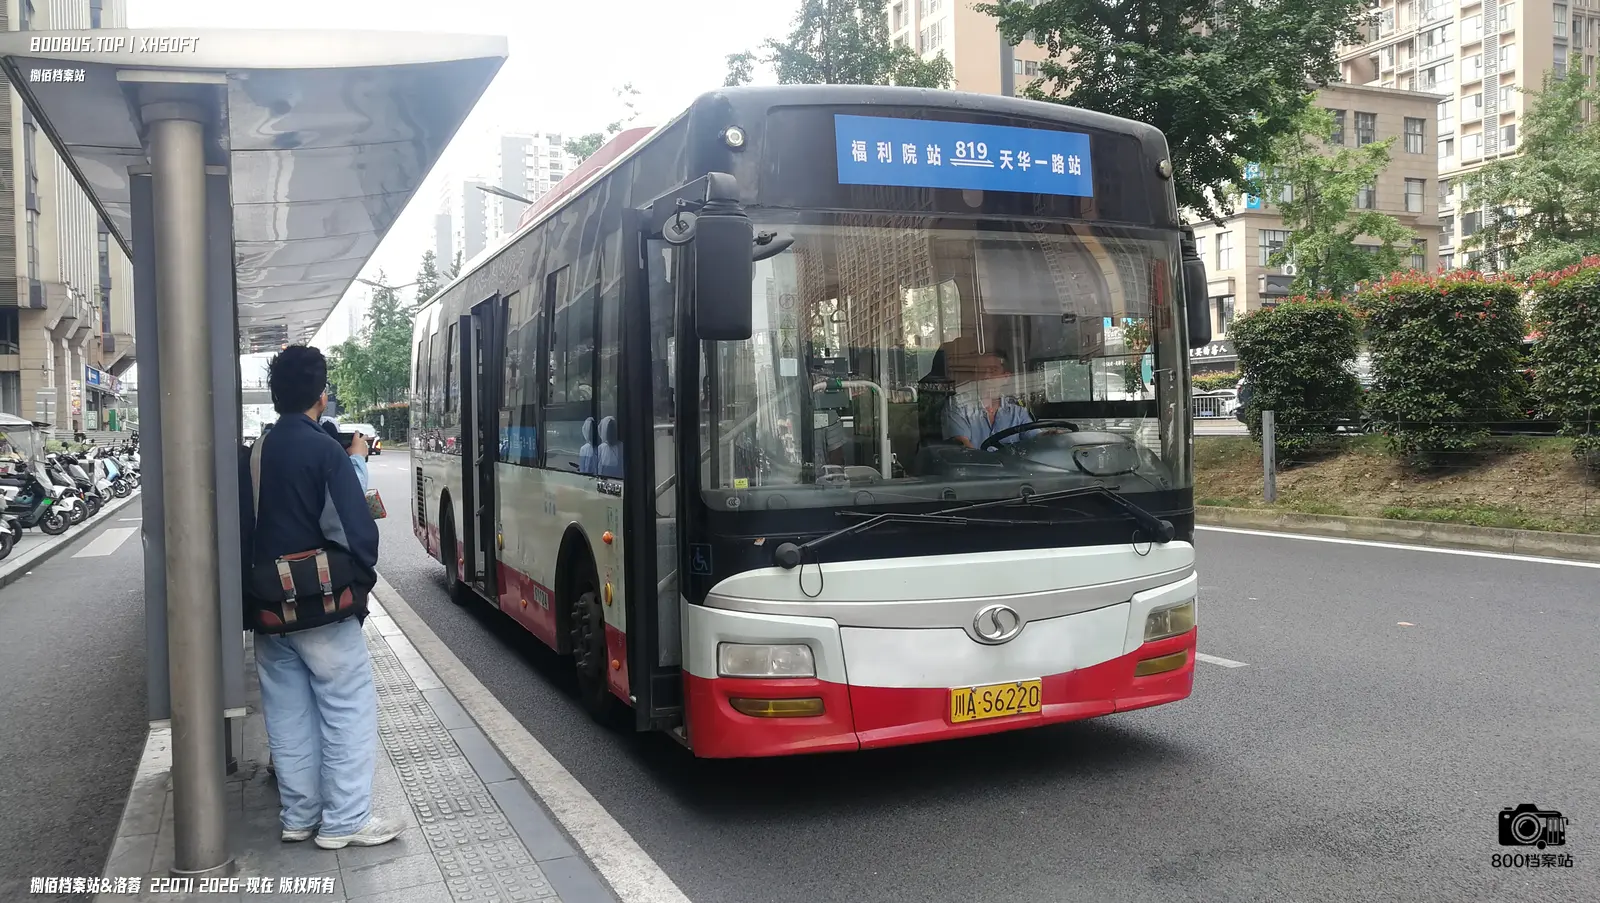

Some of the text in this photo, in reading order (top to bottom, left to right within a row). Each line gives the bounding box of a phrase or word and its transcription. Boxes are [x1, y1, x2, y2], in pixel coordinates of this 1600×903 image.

[851, 140, 1082, 176] 福利院站 819 天华一路站
